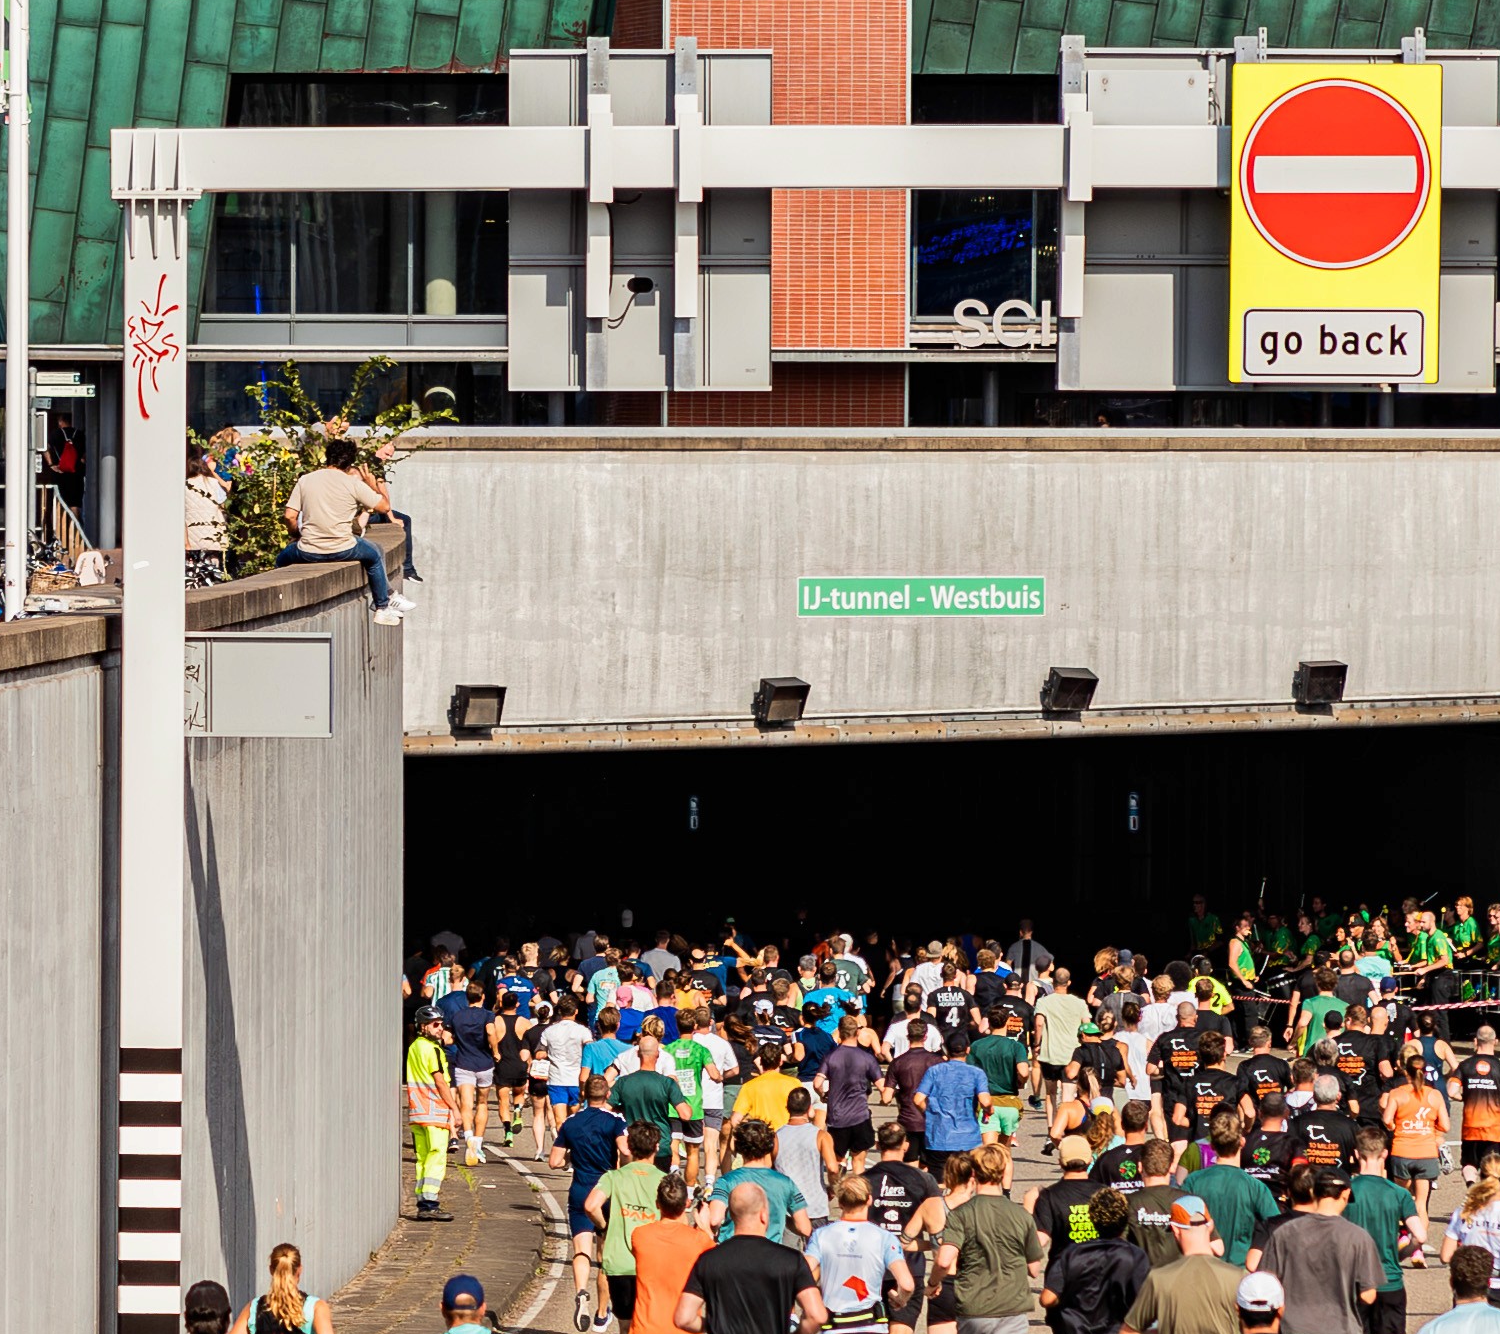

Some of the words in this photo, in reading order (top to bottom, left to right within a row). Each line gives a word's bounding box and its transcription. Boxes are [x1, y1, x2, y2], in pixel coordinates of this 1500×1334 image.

[1260, 331, 1302, 365] go
[1320, 324, 1408, 355] back
[803, 584, 910, 610] IJ-tunnel
[930, 584, 1041, 610] Westbuis
[937, 992, 965, 1002] HEMA
[945, 1007, 960, 1027] 4
